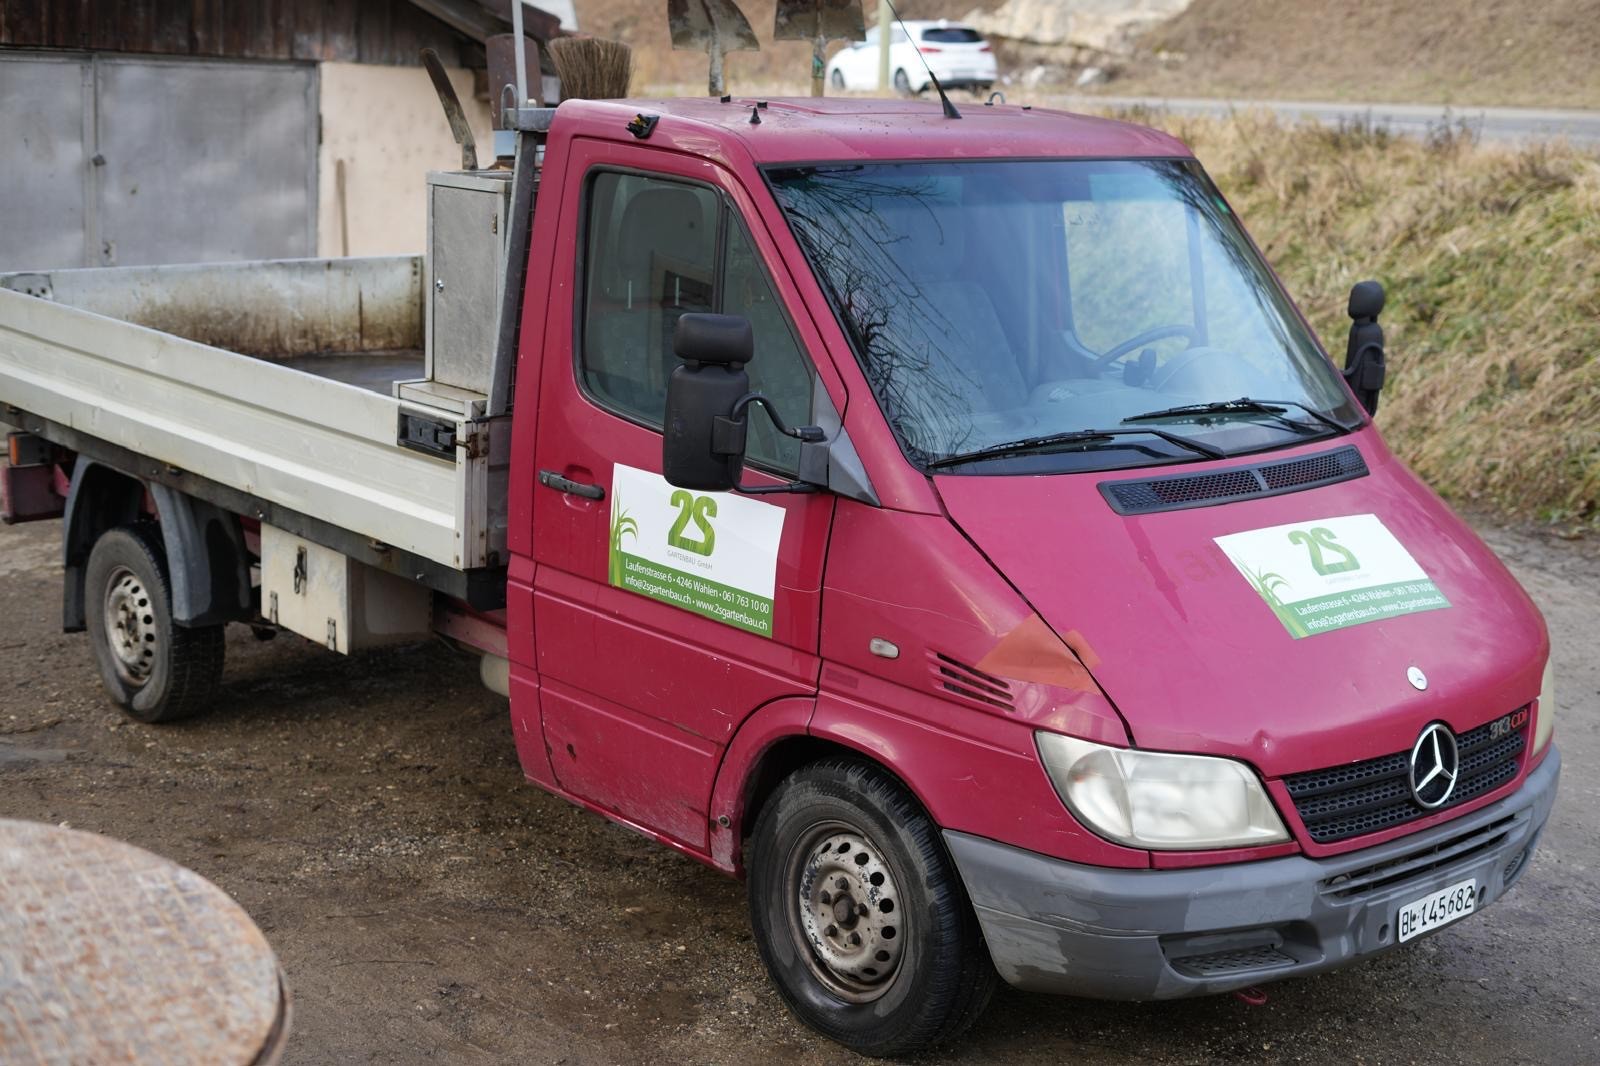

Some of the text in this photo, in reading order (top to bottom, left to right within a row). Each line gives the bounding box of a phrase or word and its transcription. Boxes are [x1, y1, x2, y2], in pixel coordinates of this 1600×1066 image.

[667, 489, 718, 556] 2S
[1288, 527, 1361, 576] 2S
[625, 574, 768, 631] info@2sgartenbau.ch www.2sgartenbau.ch
[626, 558, 769, 614] Laufenstrasse 6 4246 Wahlen 061 763 10 00
